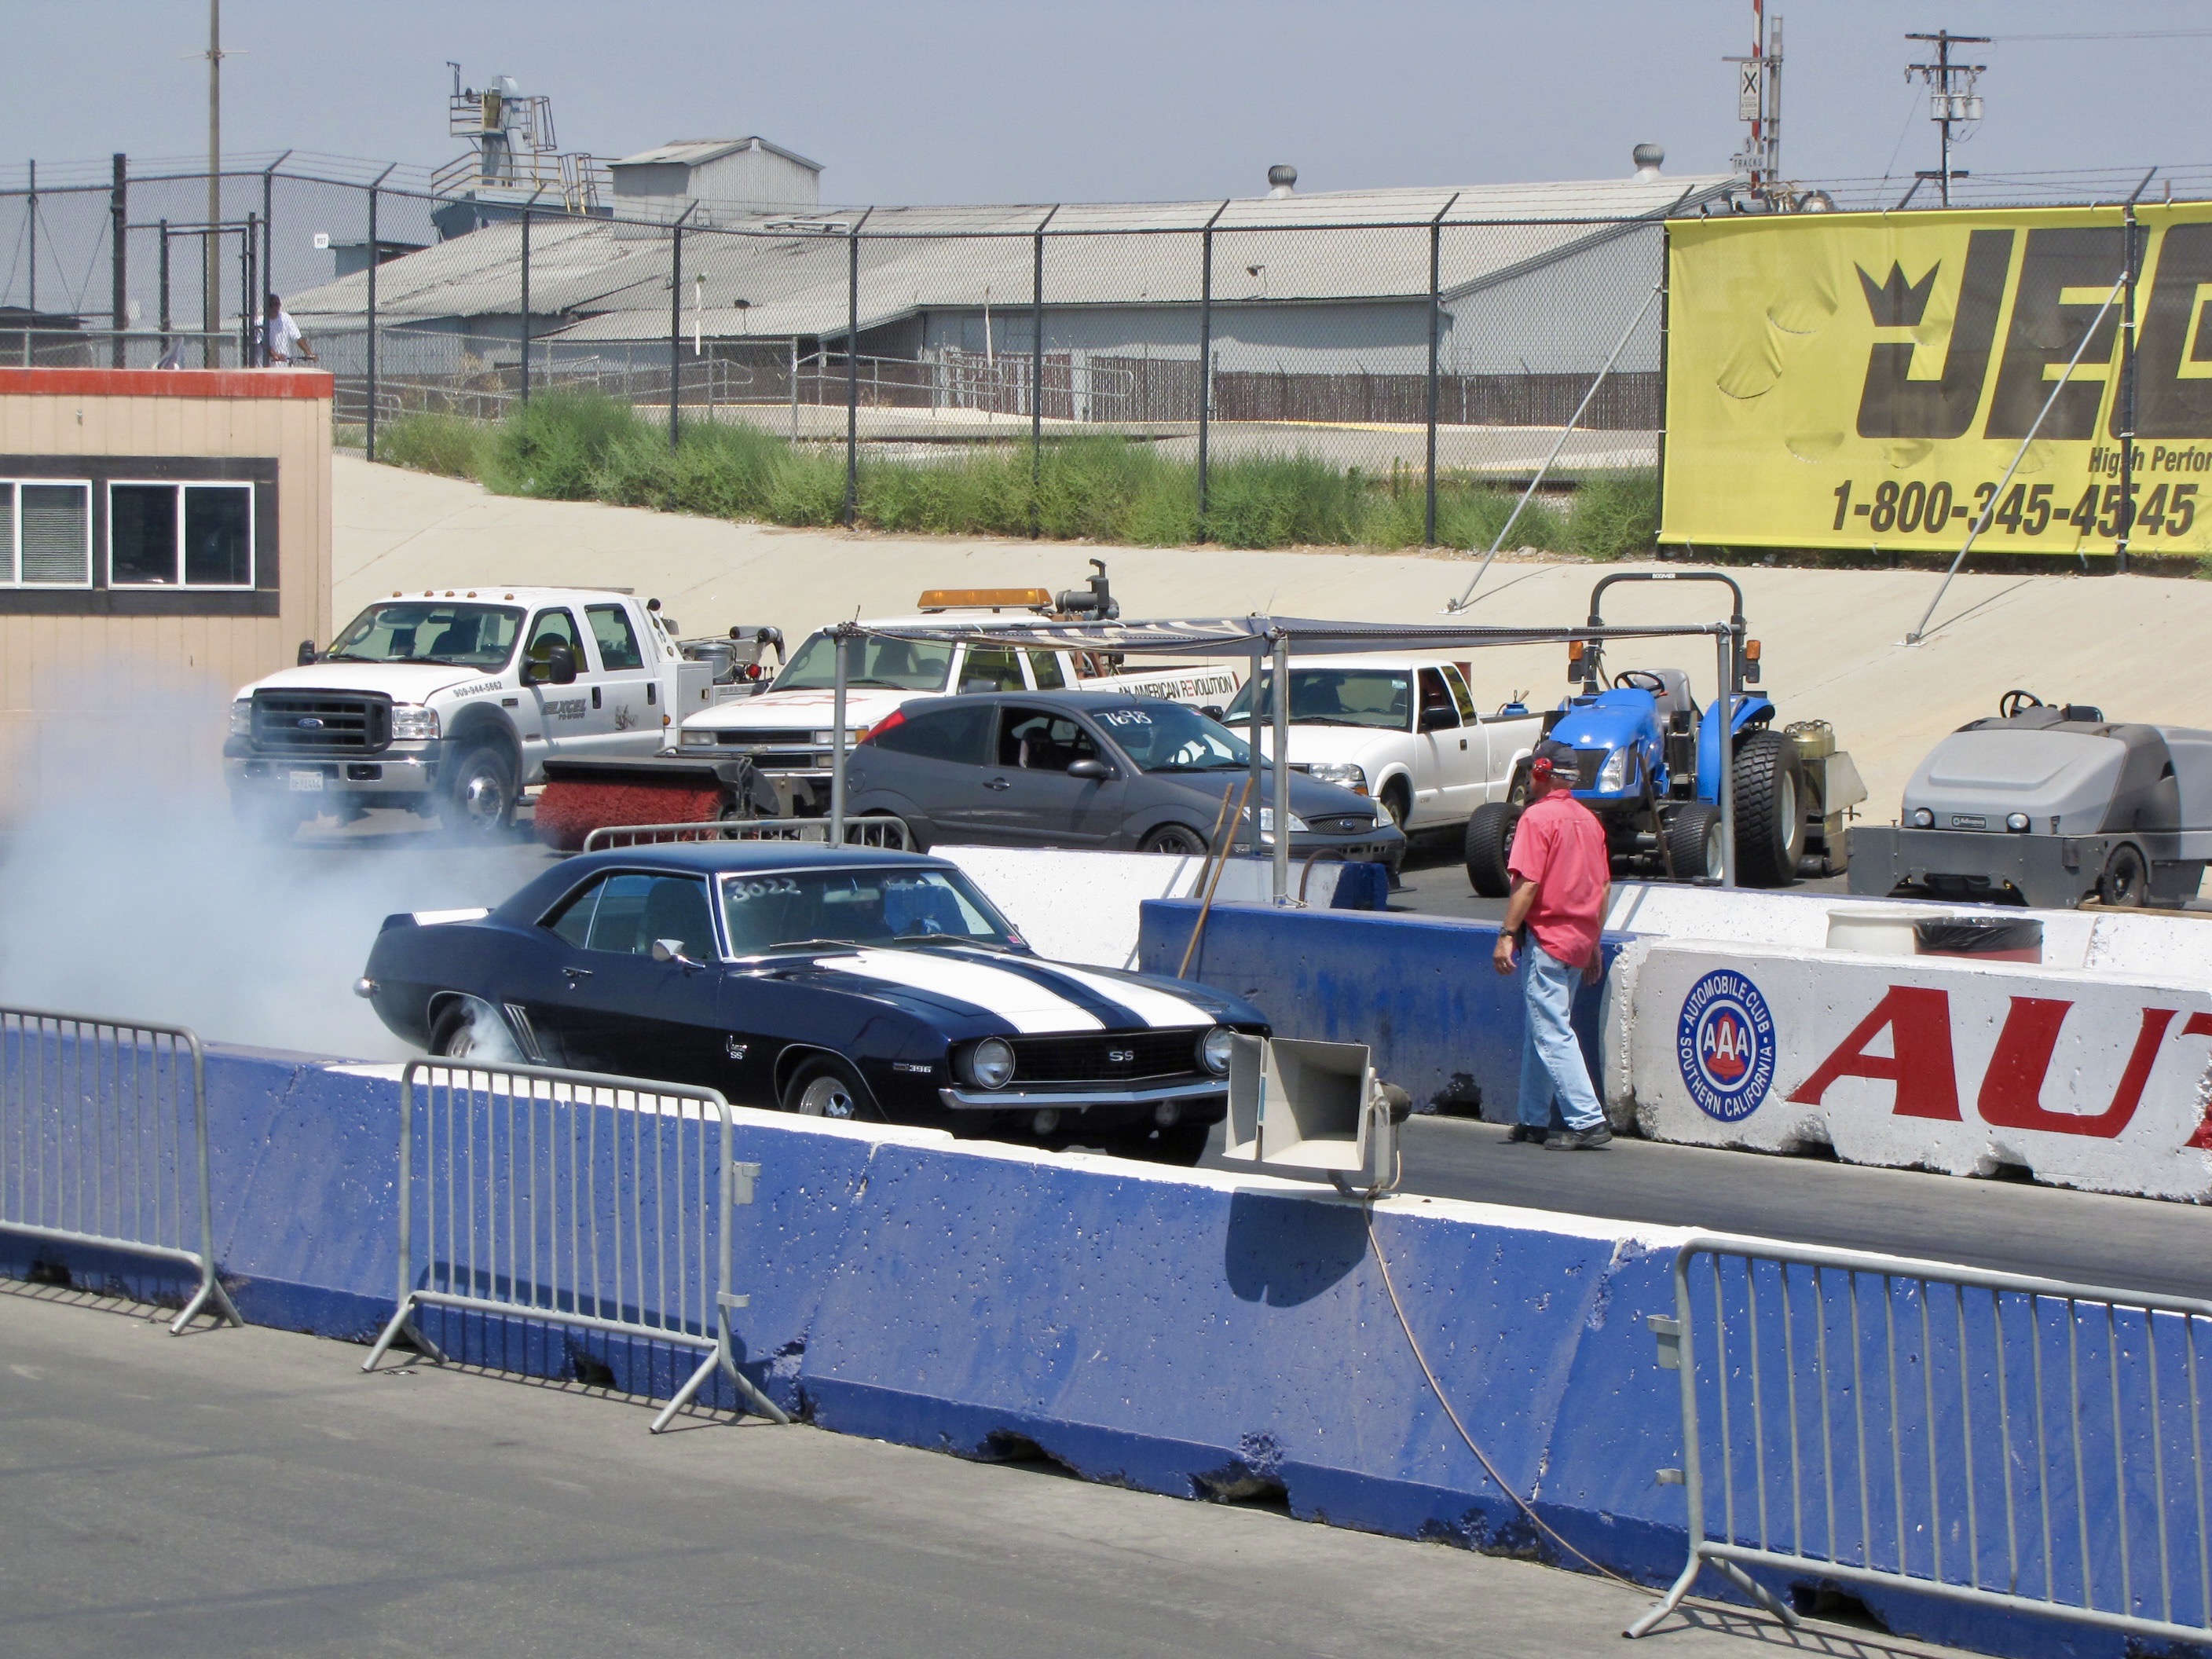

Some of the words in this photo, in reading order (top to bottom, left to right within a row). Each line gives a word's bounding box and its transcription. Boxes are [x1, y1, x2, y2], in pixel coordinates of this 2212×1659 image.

[1734, 158, 1763, 168] TRACKS
[453, 681, 503, 698] 909-944-5662
[1134, 681, 1181, 700] AMERICAN
[1181, 676, 1233, 698] REVOLUTION
[542, 698, 587, 716] EXCEL
[727, 877, 802, 903] 3022
[1683, 976, 1748, 1027] AUTOMOBILE
[1745, 991, 1770, 1034] CLUB
[1703, 1020, 1749, 1061] AAA
[730, 1051, 743, 1060] SS
[1109, 1050, 1134, 1062] SS
[909, 1064, 932, 1073] 396
[1680, 1036, 1722, 1115] SOUTHERN
[1724, 1046, 1772, 1117] CALIFORNIA
[1785, 985, 2212, 1148] AU
